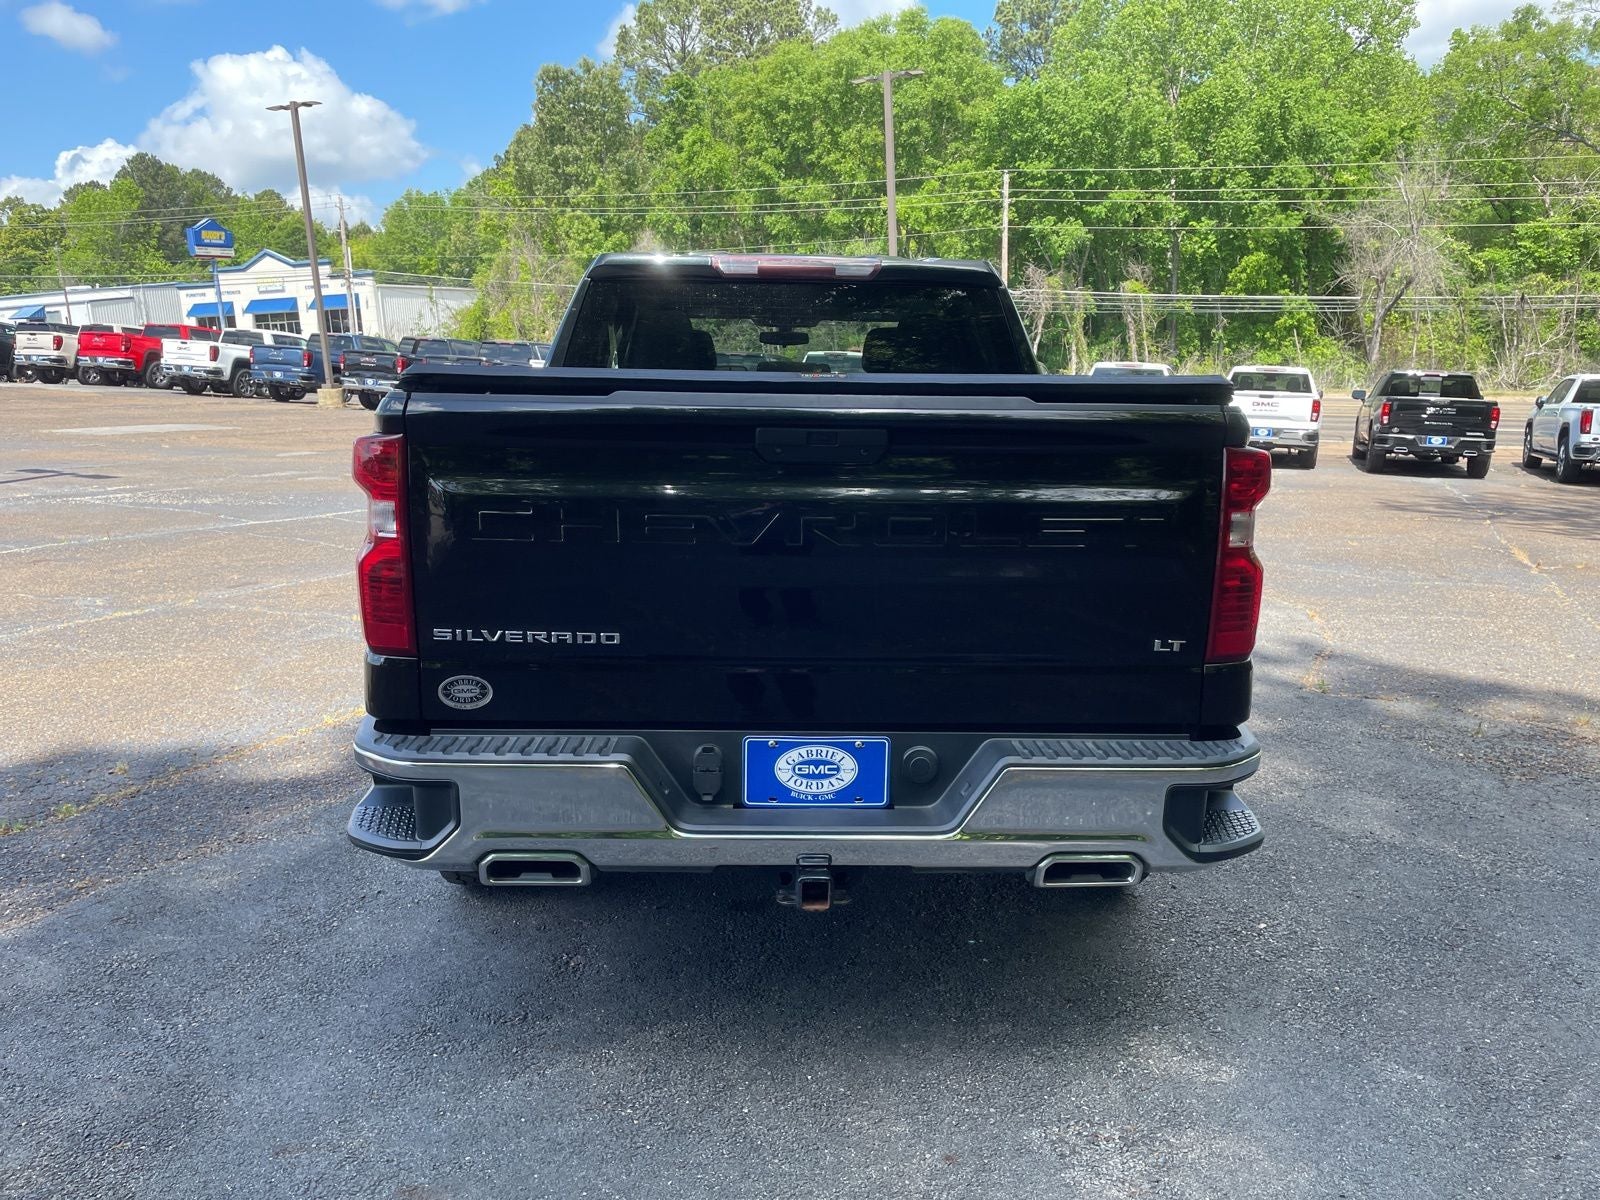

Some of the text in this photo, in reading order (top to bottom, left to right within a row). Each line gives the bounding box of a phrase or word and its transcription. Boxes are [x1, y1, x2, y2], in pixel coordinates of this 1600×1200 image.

[432, 628, 621, 645] SILVERADO
[1153, 639, 1187, 652] LT
[785, 749, 846, 766] GABRIEL
[794, 764, 838, 775] GMC
[784, 775, 846, 791] JORDAN
[790, 791, 813, 800] BUICK
